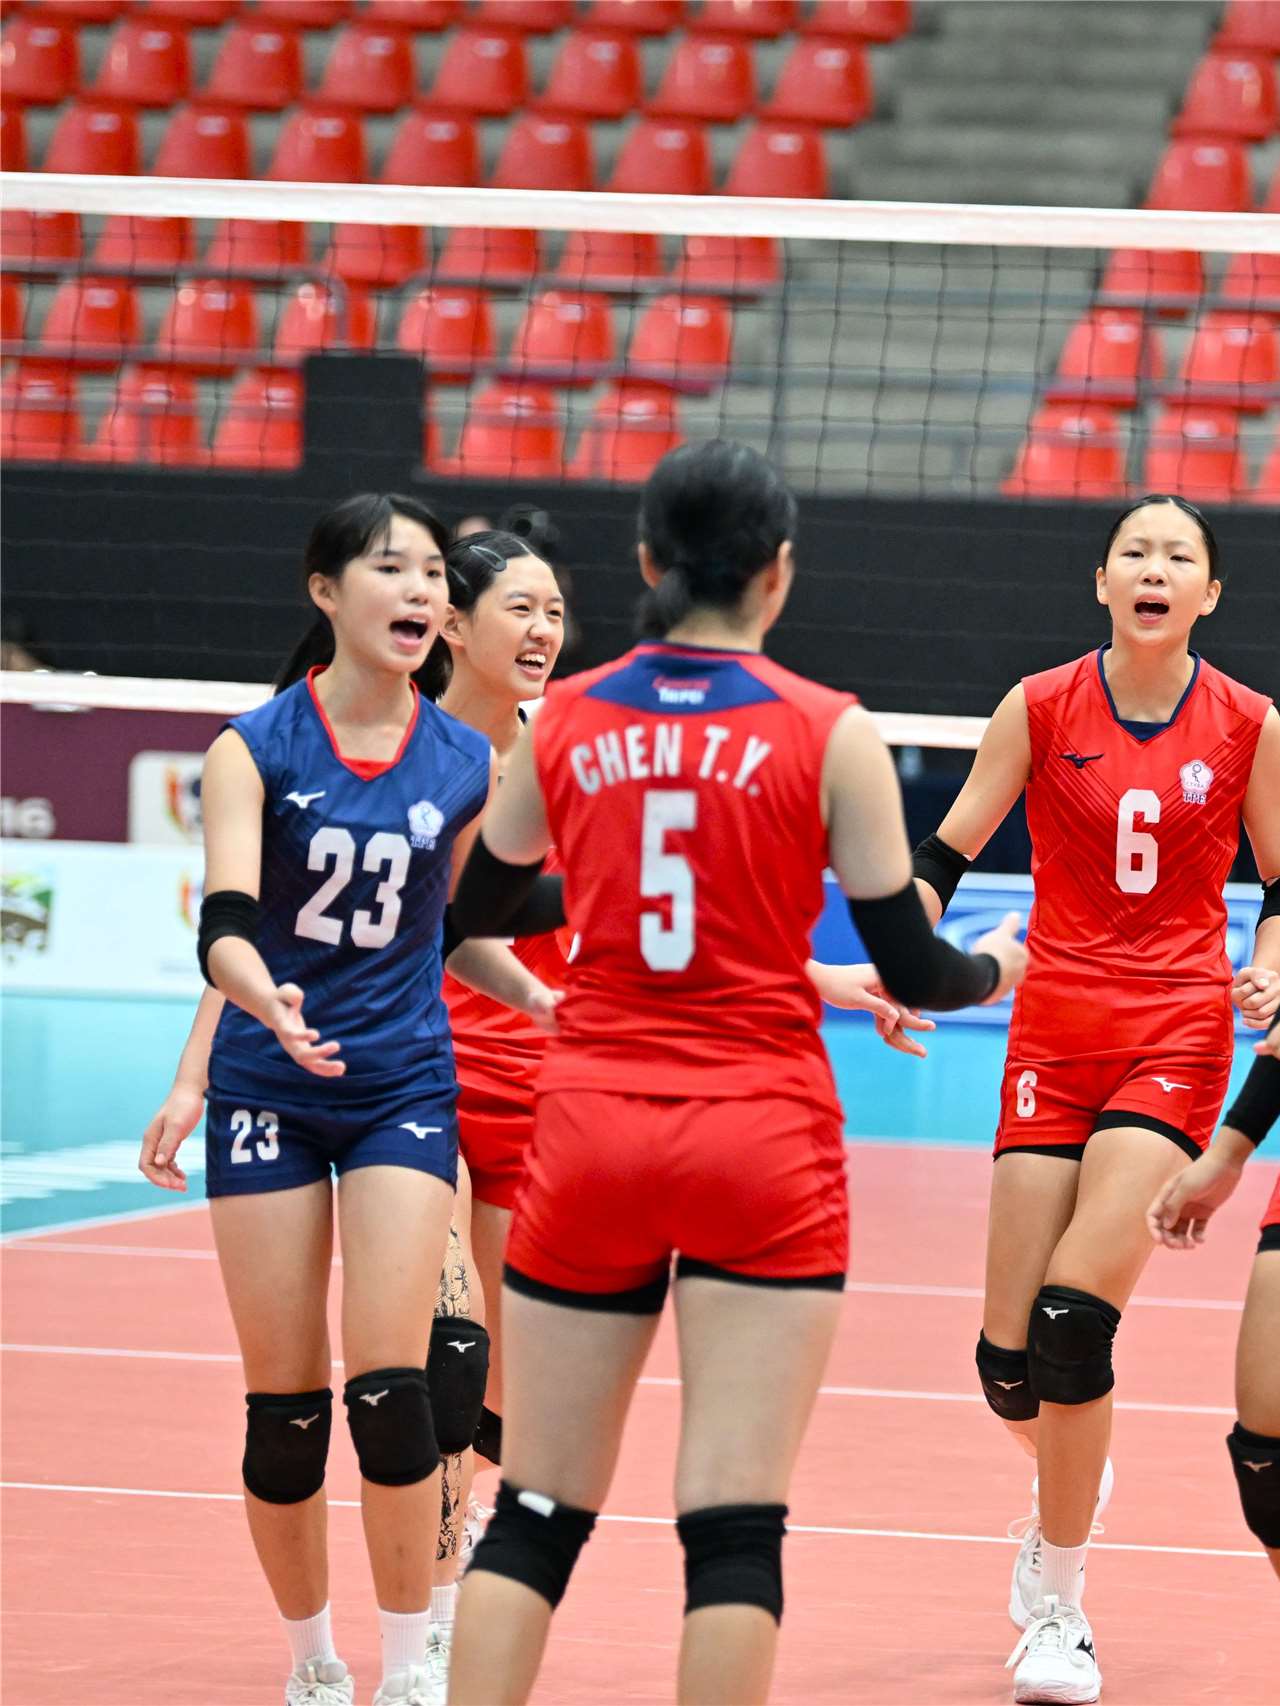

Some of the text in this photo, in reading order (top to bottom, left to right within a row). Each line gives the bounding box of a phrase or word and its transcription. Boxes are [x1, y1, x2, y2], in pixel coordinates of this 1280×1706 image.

[569, 723, 771, 796] CHEN T.Y.
[640, 790, 697, 972] 5
[1115, 789, 1160, 894] 6
[294, 827, 412, 949] 23
[230, 1109, 280, 1164] 23
[1015, 1070, 1038, 1117] 6
